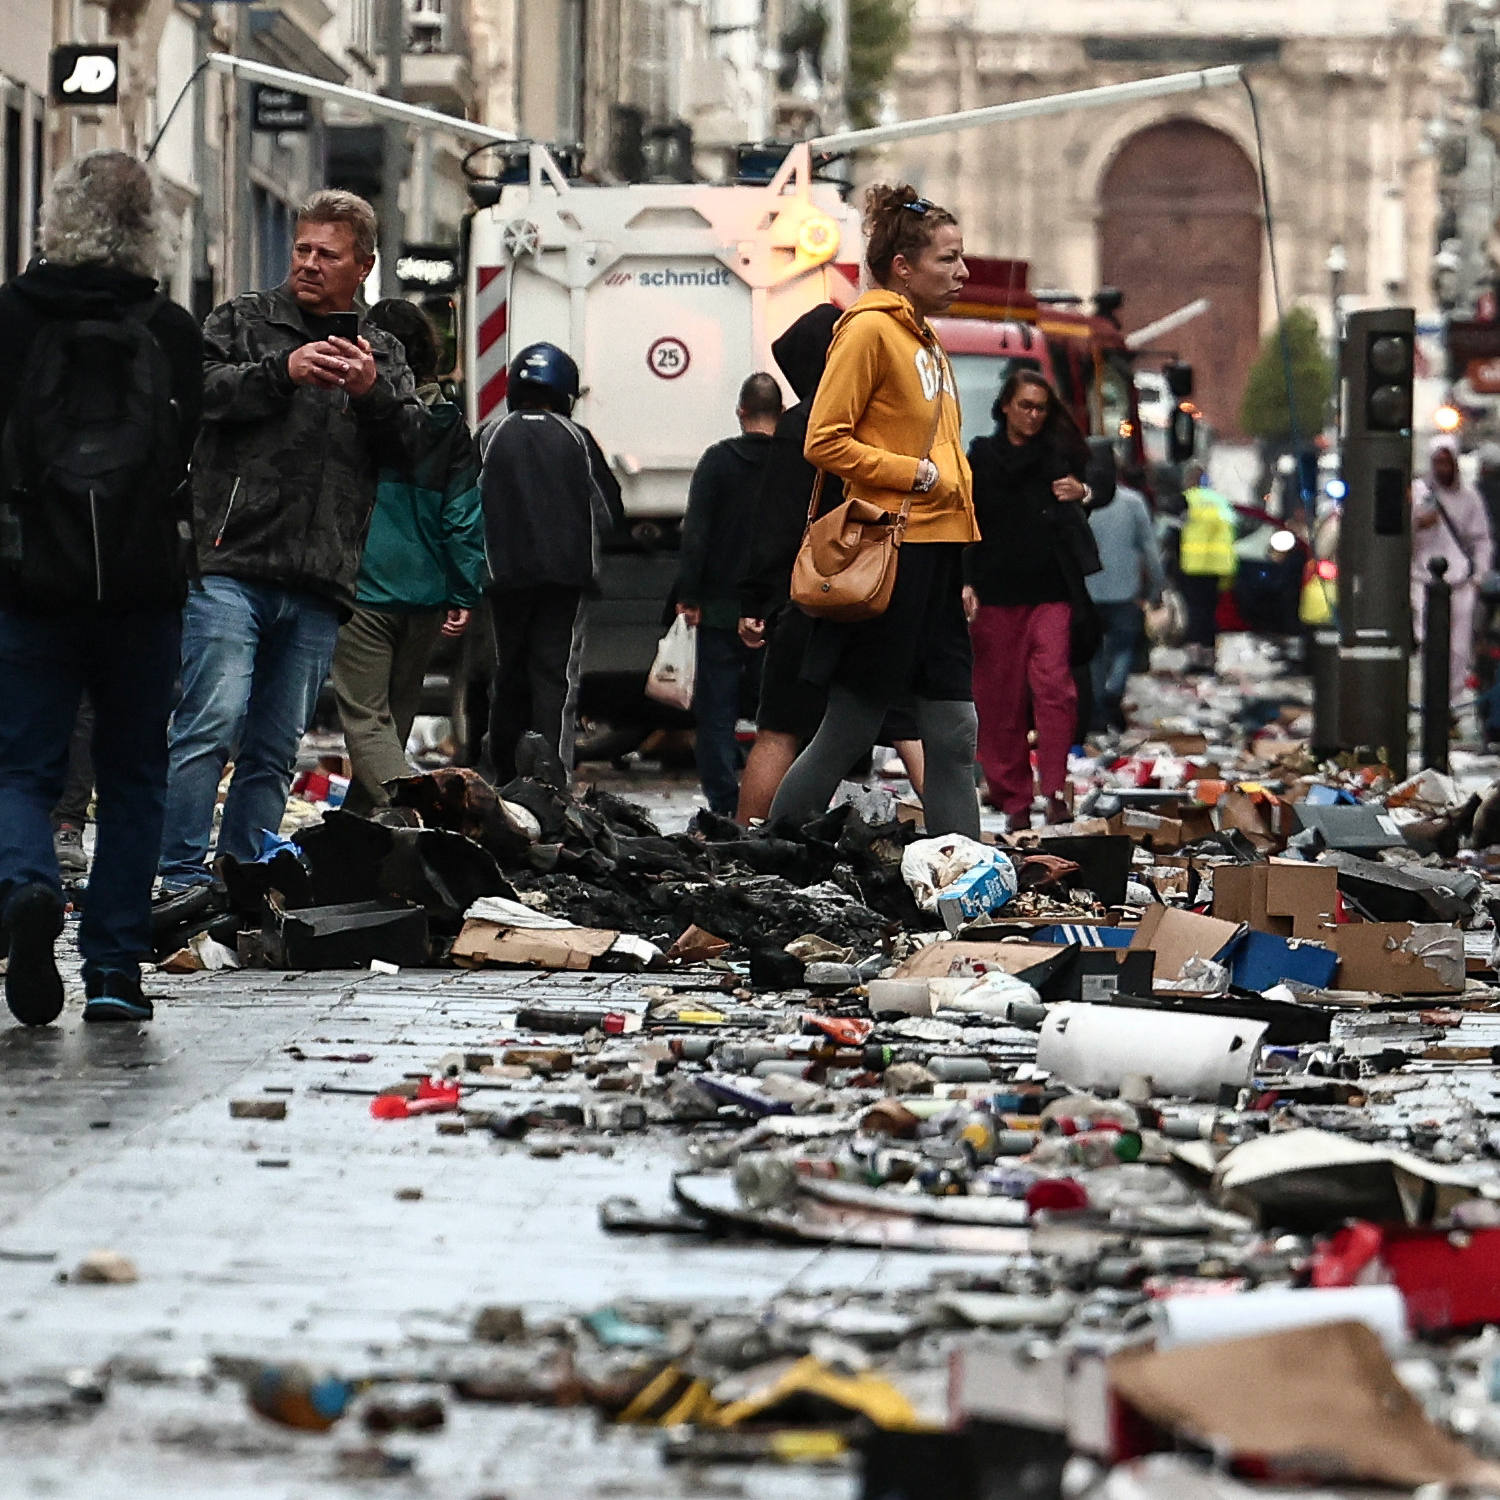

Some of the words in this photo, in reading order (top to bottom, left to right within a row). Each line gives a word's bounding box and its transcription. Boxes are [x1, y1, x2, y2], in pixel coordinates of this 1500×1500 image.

[62, 55, 117, 94] JD
[639, 268, 731, 287] schmidt
[657, 348, 680, 368] 25
